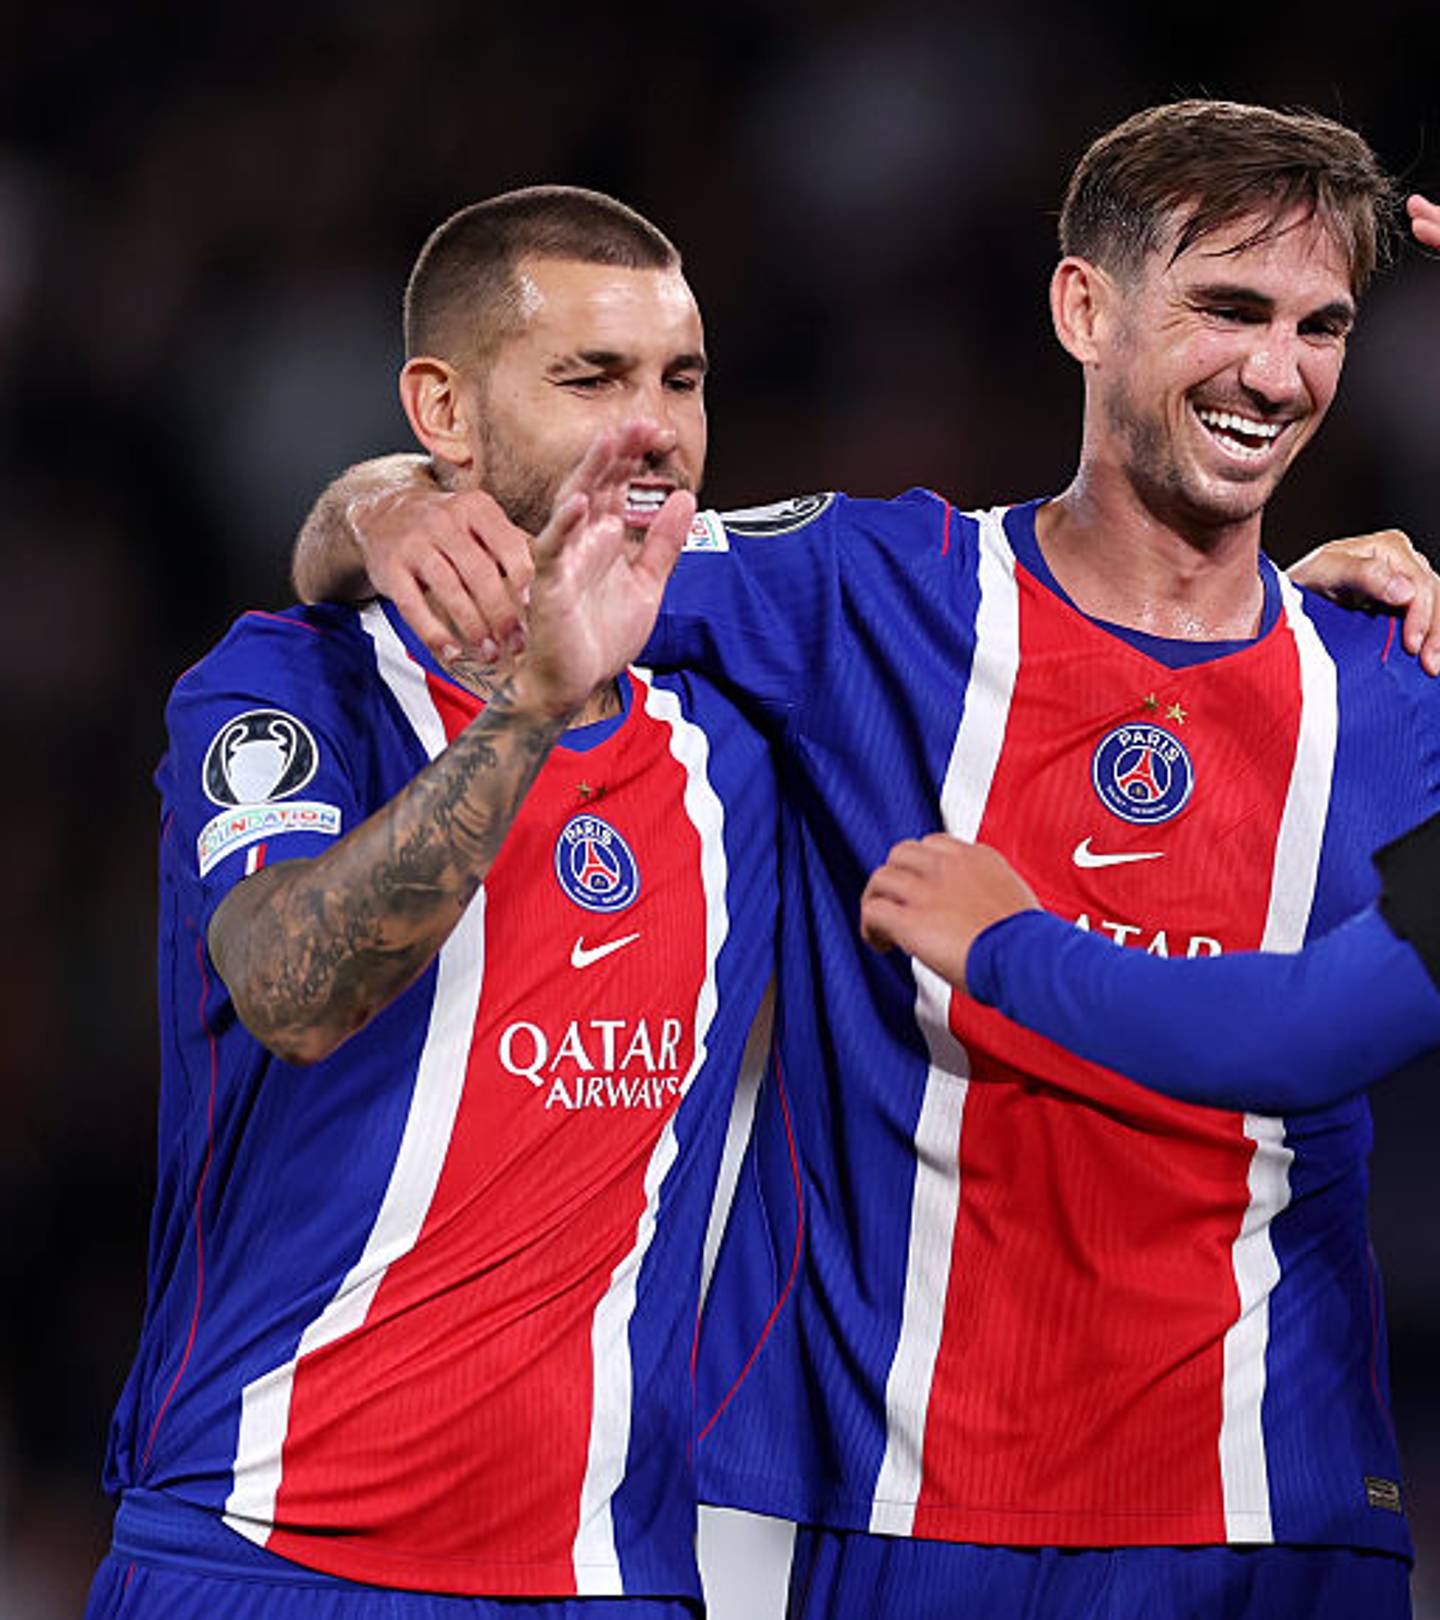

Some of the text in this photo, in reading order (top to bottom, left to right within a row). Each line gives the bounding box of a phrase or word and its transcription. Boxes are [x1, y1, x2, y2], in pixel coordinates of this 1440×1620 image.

[1118, 731, 1180, 762] PARIS
[499, 1018, 682, 1087] QATAR
[545, 1076, 679, 1109] AIRWAYS
